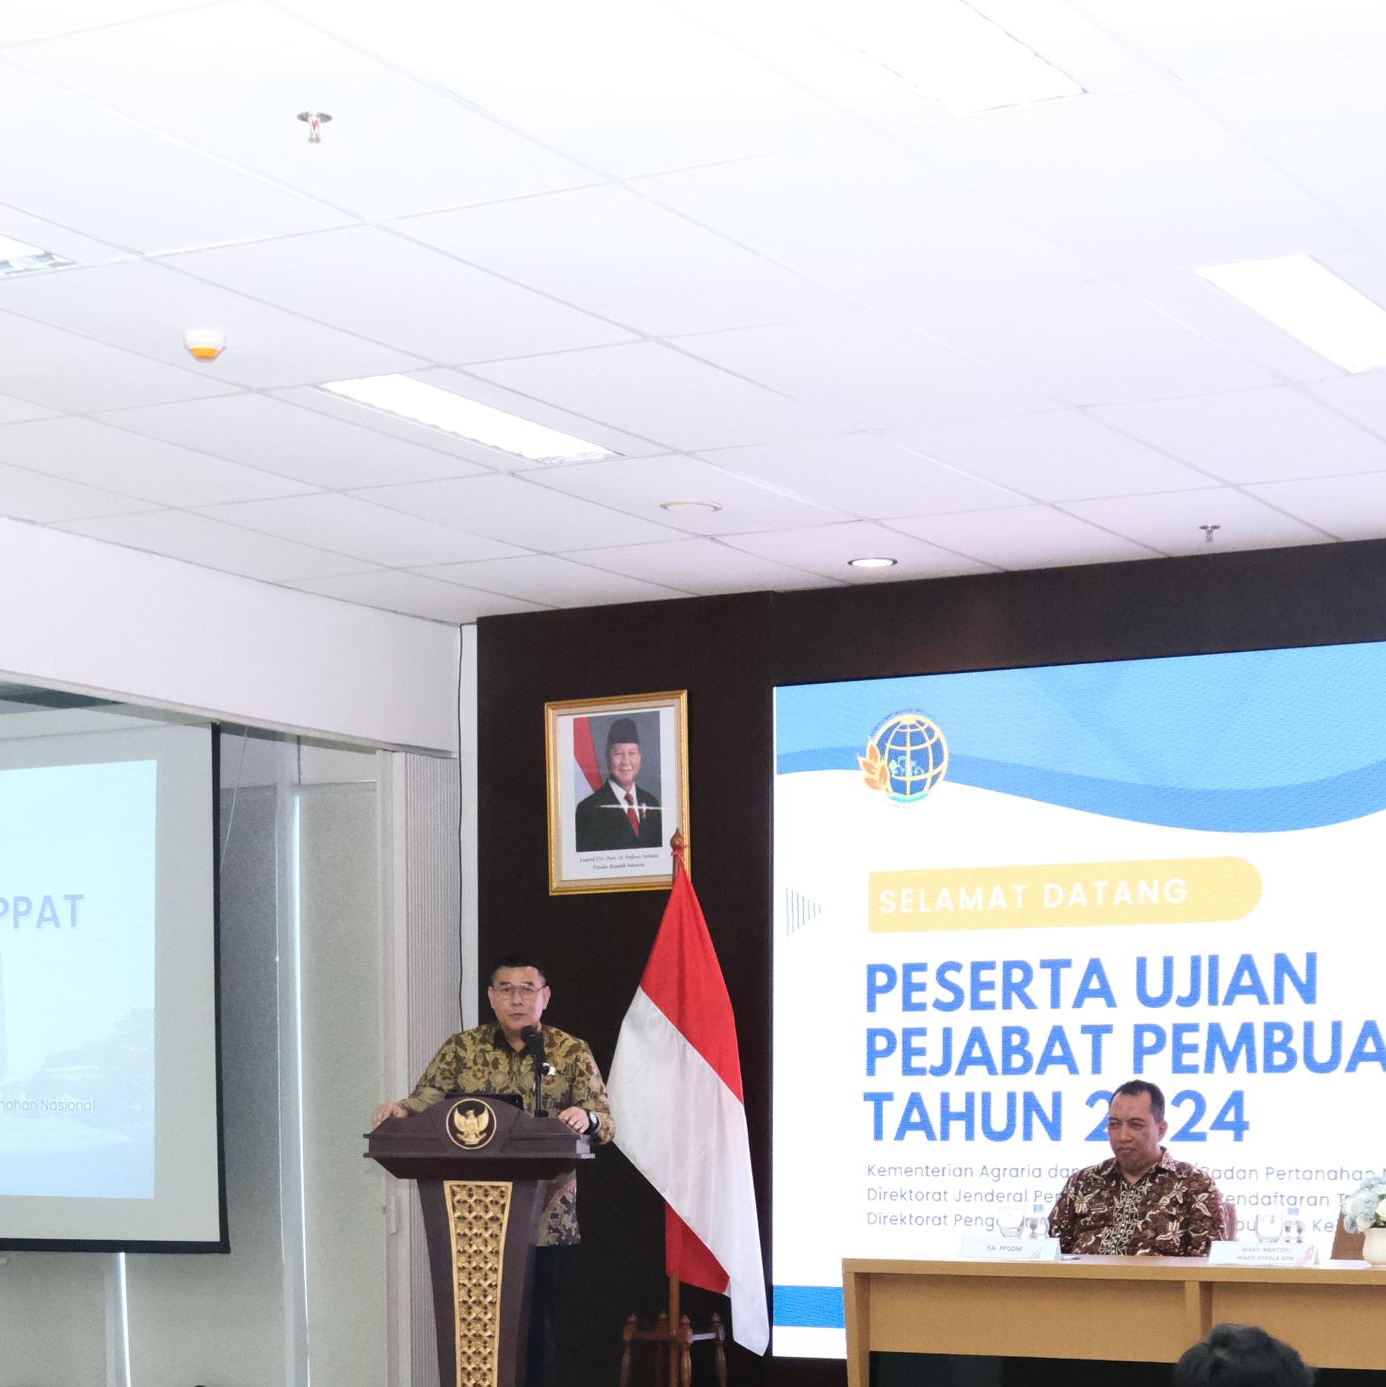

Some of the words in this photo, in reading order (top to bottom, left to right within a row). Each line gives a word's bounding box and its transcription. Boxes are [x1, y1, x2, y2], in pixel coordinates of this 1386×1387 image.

[879, 885, 1029, 914] SELAMAT
[1043, 877, 1189, 907] DATANG
[866, 957, 1118, 1013] PESERTA
[1135, 952, 1318, 1009] UJIAN
[866, 1023, 1114, 1077] PEJABAT
[41, 1099, 96, 1112] Nasional
[863, 1091, 1062, 1142] TAHUN
[1085, 1089, 1251, 1142] 224
[867, 1164, 973, 1178] Kementerian
[980, 1164, 1042, 1183] Agraria
[1266, 1166, 1375, 1181] Pertanahan
[867, 1188, 948, 1202] Direktorat
[954, 1189, 1027, 1203] Jenderal
[1226, 1191, 1330, 1207] endaftaran
[867, 1212, 948, 1226] Direktorat
